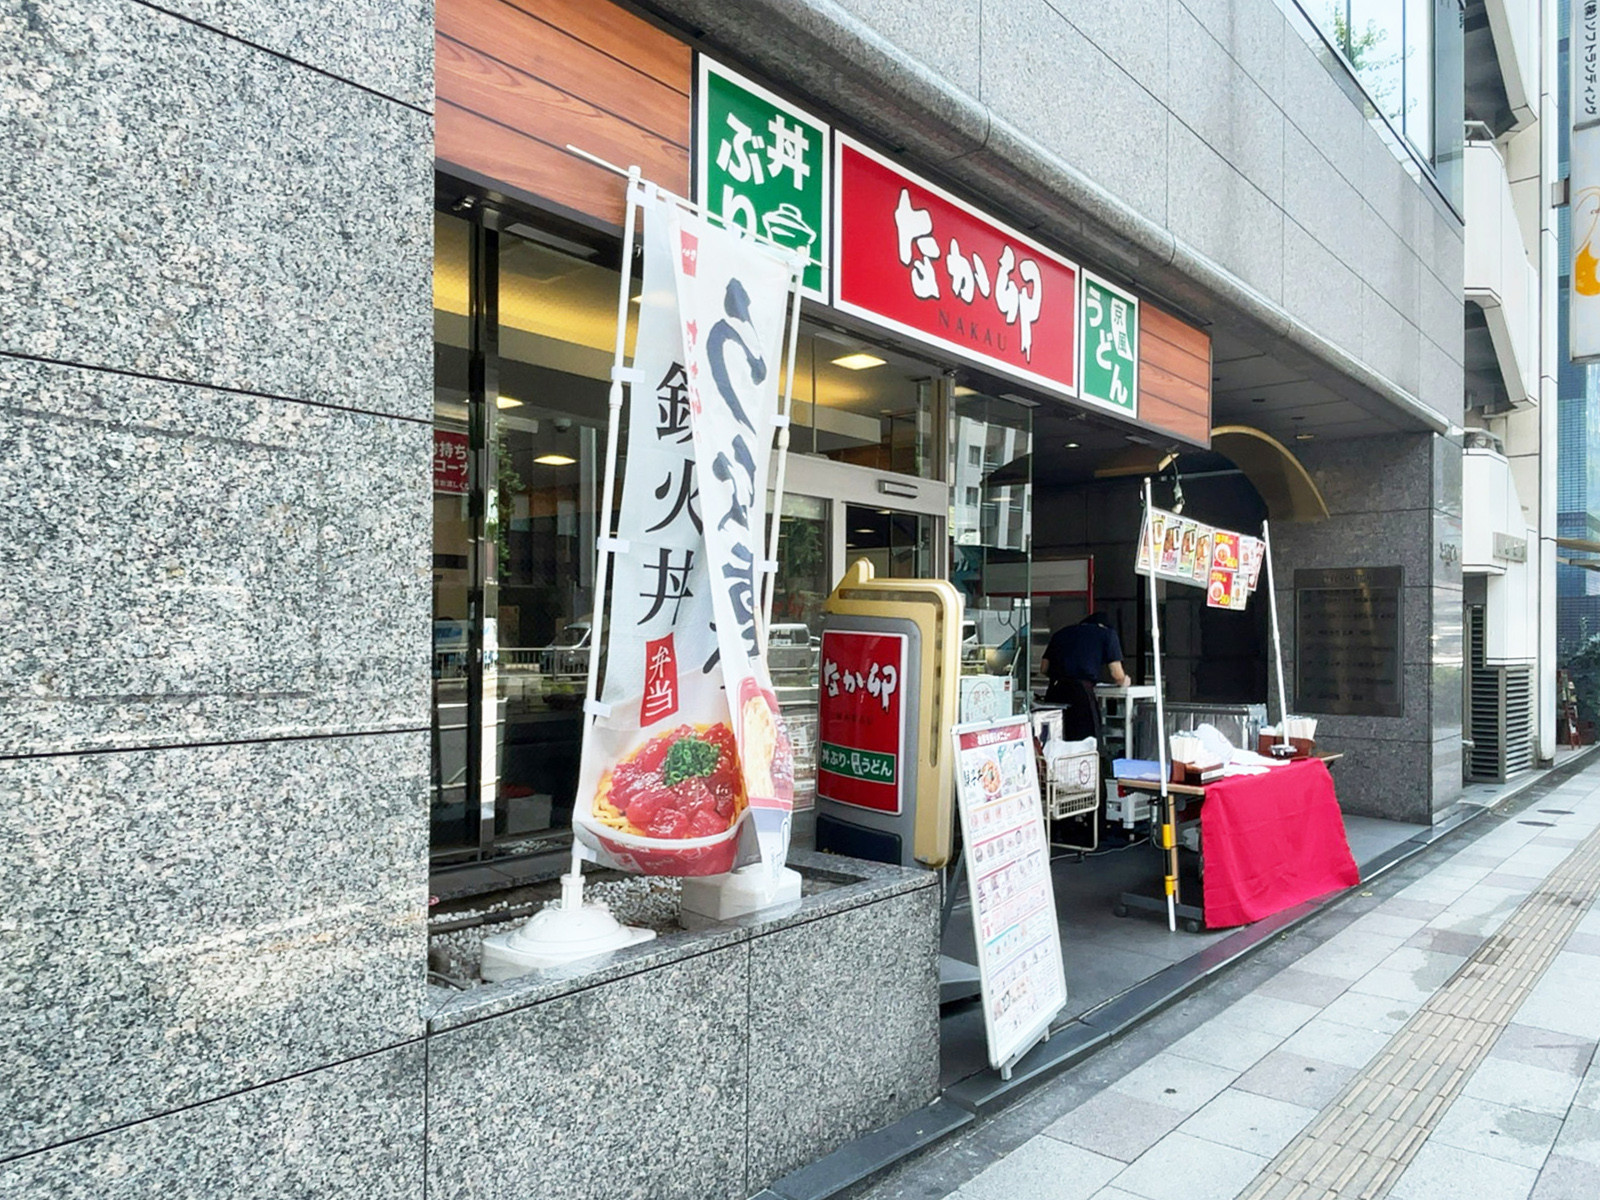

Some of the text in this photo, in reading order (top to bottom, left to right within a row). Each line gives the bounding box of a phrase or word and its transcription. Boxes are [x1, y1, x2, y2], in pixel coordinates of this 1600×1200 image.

[893, 186, 1044, 364] なか卯
[938, 308, 1008, 352] NAKAU
[1086, 286, 1129, 405] うどん
[644, 645, 673, 718] 弁当
[823, 658, 898, 713] なか卯
